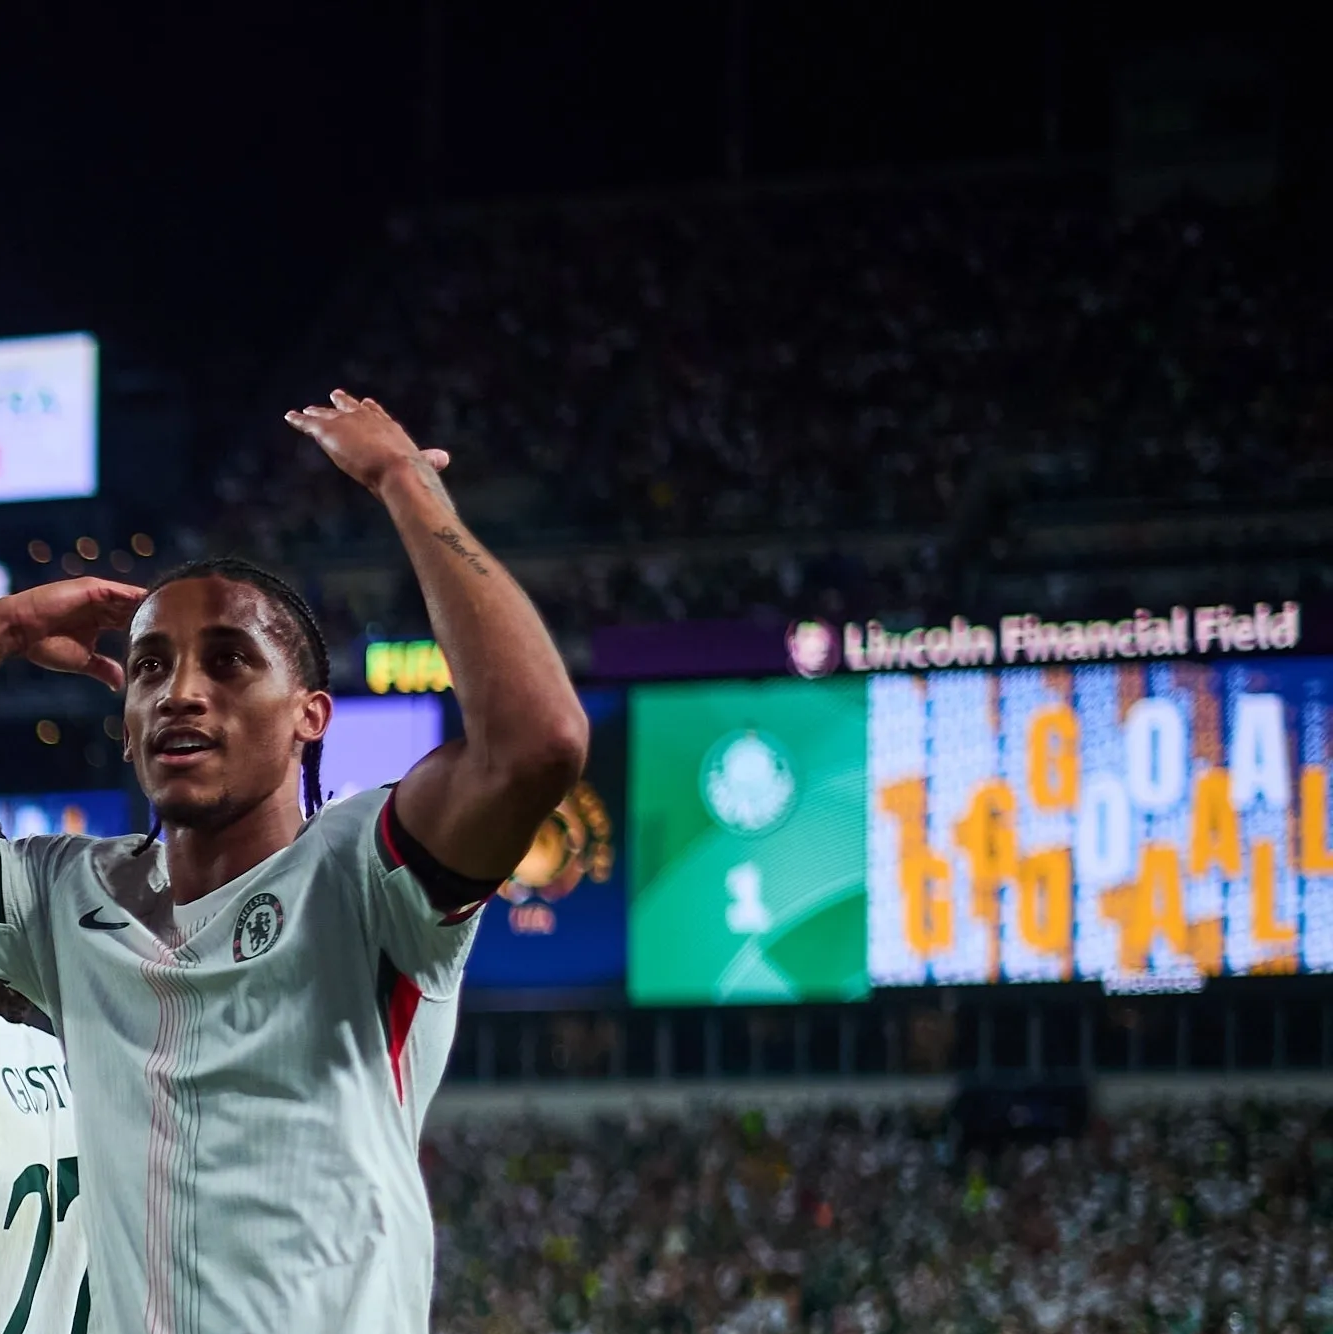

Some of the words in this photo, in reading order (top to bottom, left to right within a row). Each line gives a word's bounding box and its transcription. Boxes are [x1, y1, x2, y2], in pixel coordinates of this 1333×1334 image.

[843, 616, 996, 672] Lincoln
[999, 603, 1187, 664] Financial
[1194, 598, 1301, 652] Field
[724, 862, 771, 936] 1
